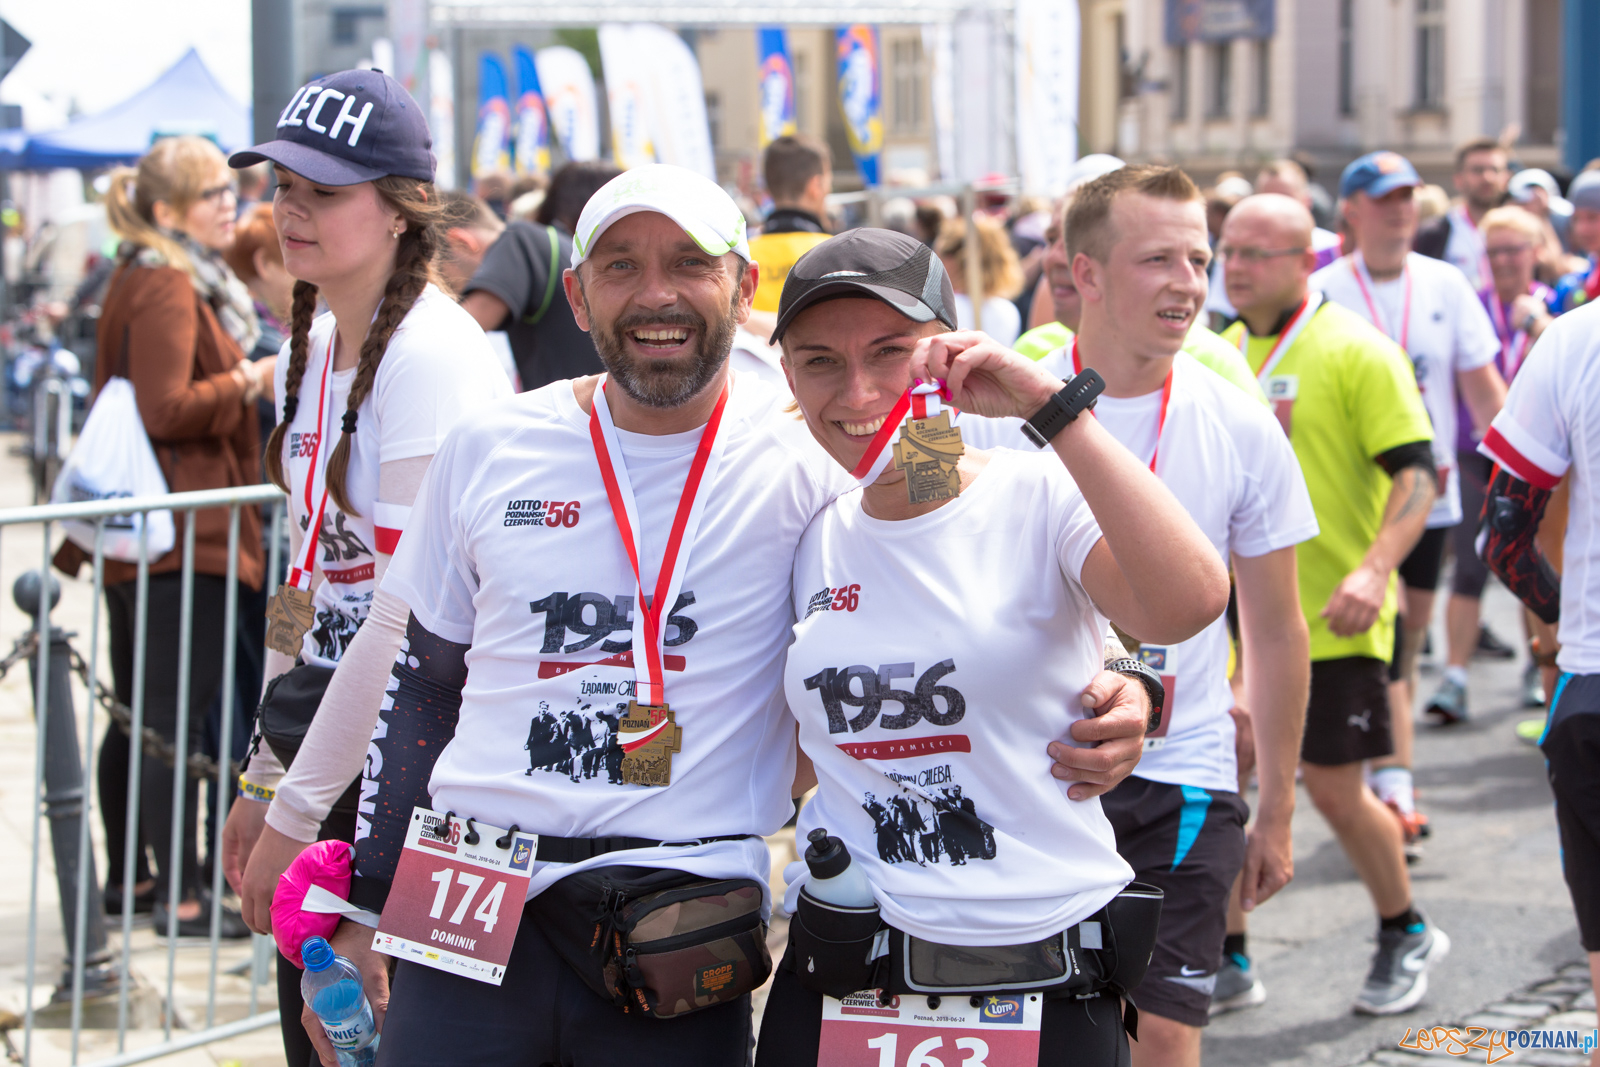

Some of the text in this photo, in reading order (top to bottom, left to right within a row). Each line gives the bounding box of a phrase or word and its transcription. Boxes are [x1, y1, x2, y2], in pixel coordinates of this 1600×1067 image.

[276, 86, 374, 147] LECH
[507, 500, 542, 510] LOTTO
[505, 510, 546, 518] POZNAŃSKI
[503, 518, 545, 526] CZERWIEC
[581, 680, 617, 697] ŻĄDAMY
[803, 658, 966, 734] 1956
[622, 718, 650, 728] POZNAŃ
[890, 740, 953, 753] PAMIĘCI
[918, 764, 952, 787] CHLEBA
[423, 815, 443, 827] LOTTO
[429, 867, 507, 933] 174
[430, 928, 477, 951] DOMINIK
[703, 964, 733, 979] CROPP
[841, 999, 875, 1007] CZERWIEC
[991, 1003, 1013, 1014] LOTTO
[326, 1023, 363, 1040] YWIEC
[867, 1032, 990, 1067] 163
